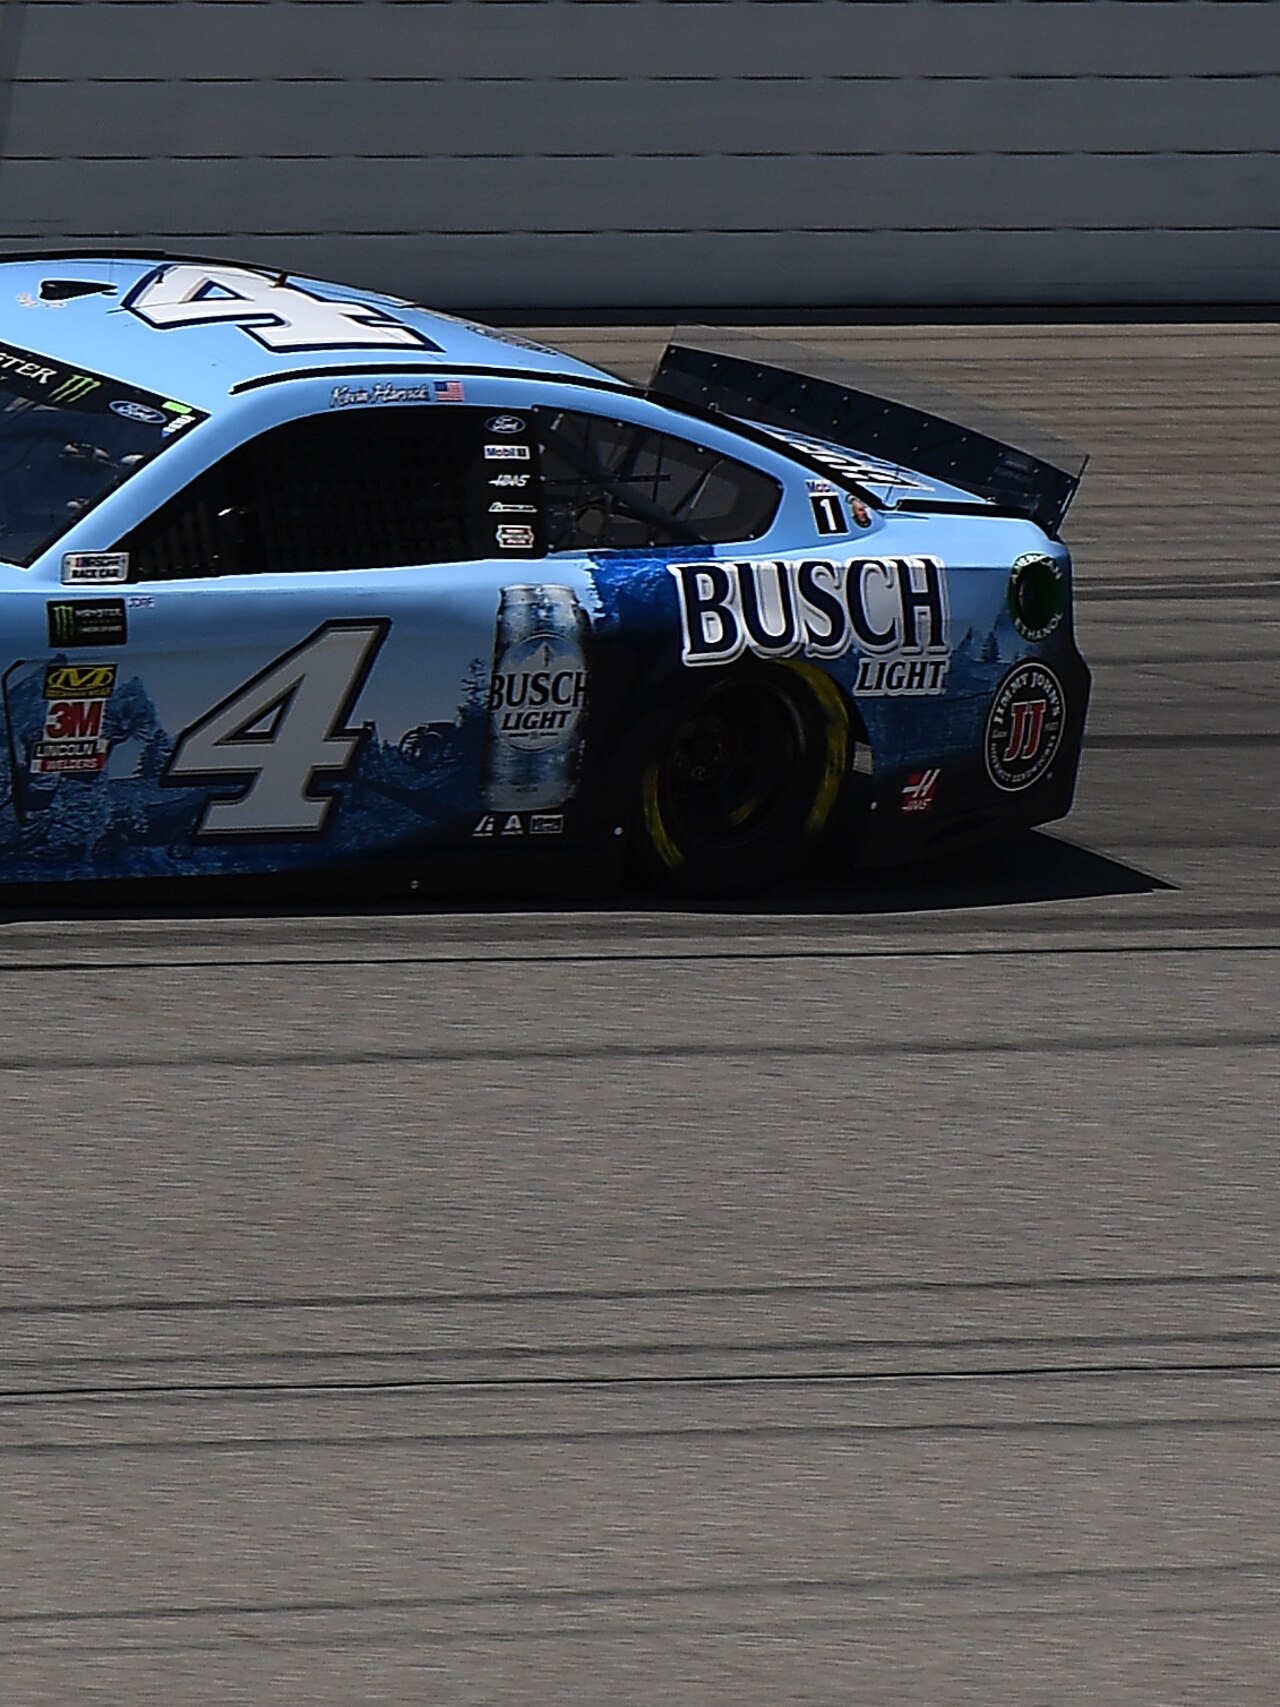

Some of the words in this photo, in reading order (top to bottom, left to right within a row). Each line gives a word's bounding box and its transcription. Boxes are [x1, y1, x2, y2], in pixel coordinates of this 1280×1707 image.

[121, 264, 445, 352] 4
[820, 498, 838, 531] 1
[675, 557, 949, 660] BUSCH
[488, 671, 589, 710] BUSCH
[855, 660, 947, 692] LIGHT
[47, 701, 102, 738] 3M
[162, 617, 391, 842] 4
[501, 710, 571, 730] LIGHT
[1003, 699, 1047, 761] JJ
